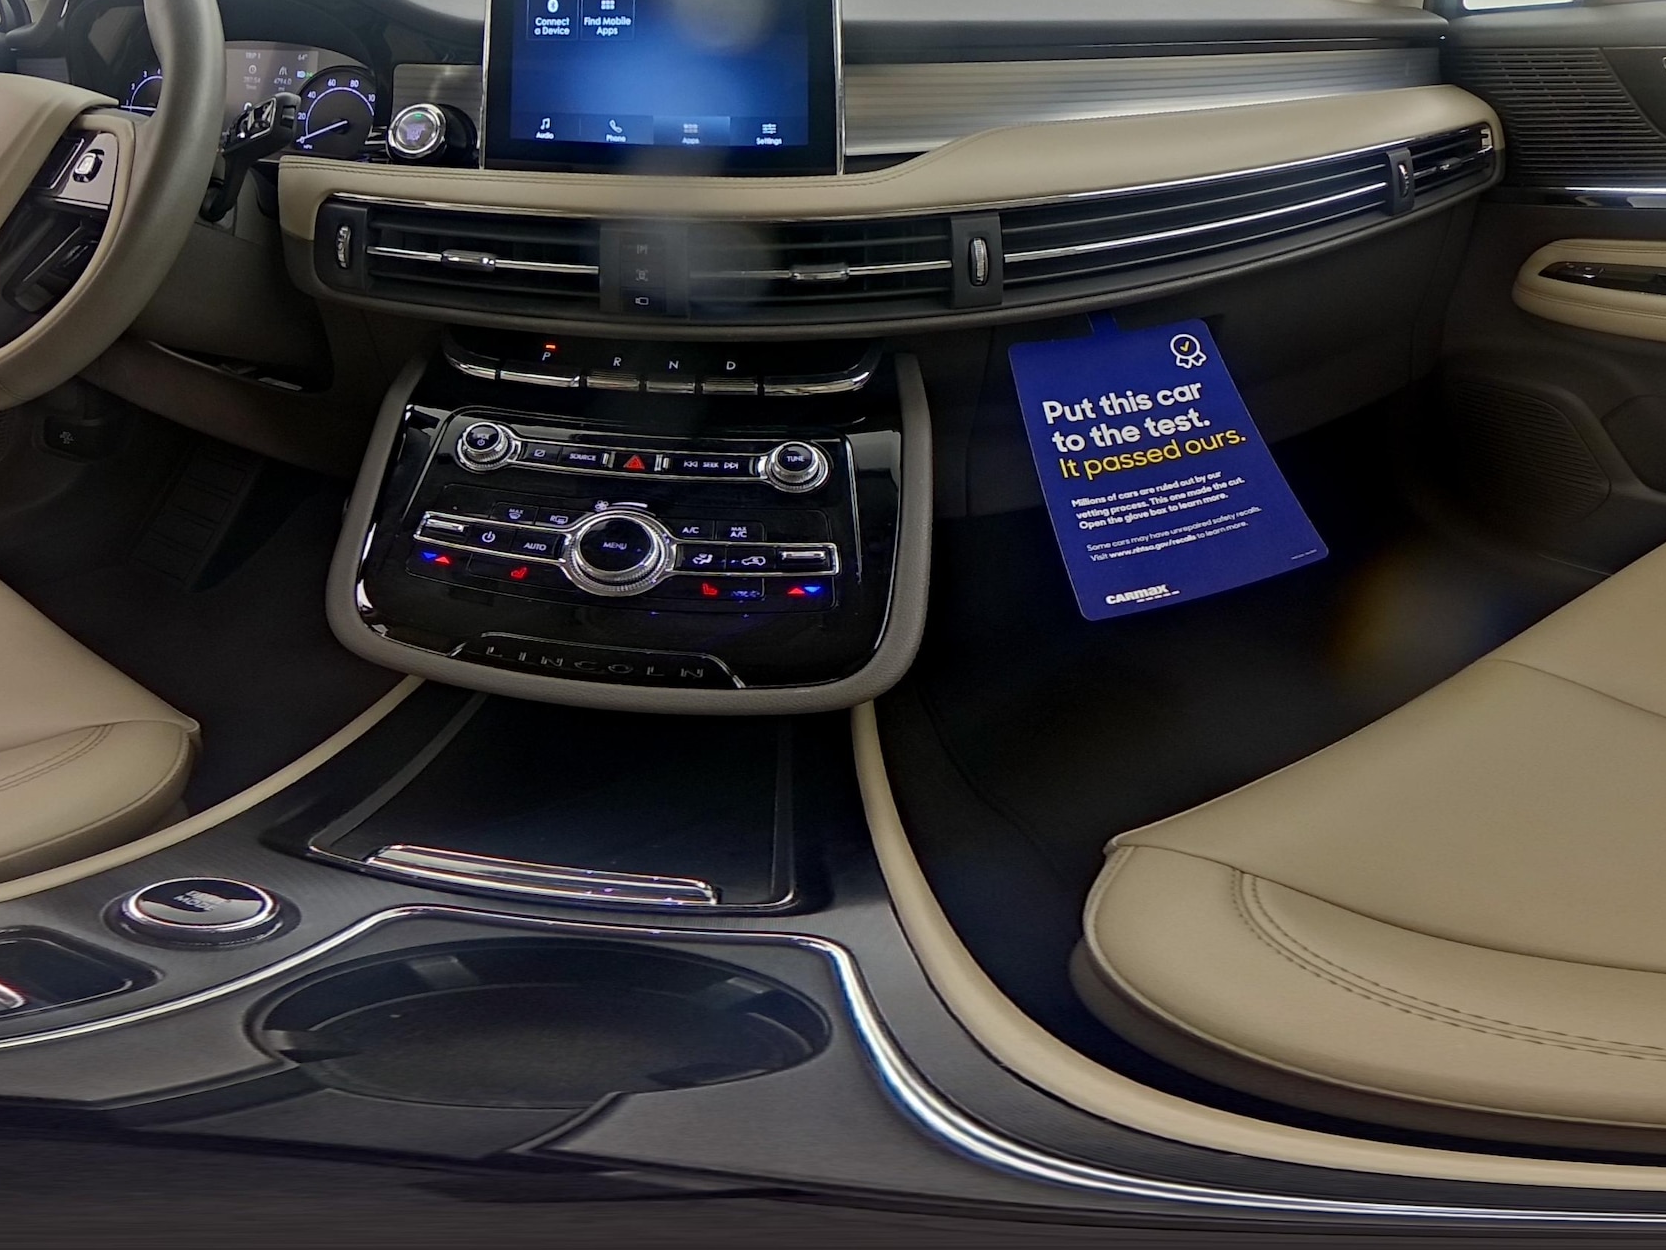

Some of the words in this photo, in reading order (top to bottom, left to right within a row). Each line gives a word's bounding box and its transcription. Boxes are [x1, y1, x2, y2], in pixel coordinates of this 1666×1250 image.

[535, 17, 570, 26] Connect
[584, 17, 601, 26] Find
[603, 16, 631, 26] Mobile
[542, 27, 570, 36] Device
[596, 27, 618, 37] Apps
[327, 79, 337, 87] 60
[350, 79, 359, 88] 80
[307, 91, 317, 99] 40
[297, 112, 307, 120] 20
[542, 352, 551, 361] P
[613, 357, 621, 367] R
[668, 360, 678, 370] N
[726, 361, 736, 370] D
[1043, 398, 1096, 424] Put
[1099, 391, 1152, 415] this
[1157, 383, 1201, 405] car
[1052, 431, 1085, 452] to
[1090, 424, 1140, 447] the
[1144, 408, 1210, 437] test.
[569, 453, 596, 462] SOURCE
[786, 455, 805, 463] TUNE
[1060, 458, 1080, 478] It
[1084, 439, 1181, 480] passed
[1185, 430, 1246, 453] ours.
[1071, 497, 1106, 507] Millions
[1107, 493, 1116, 501] of
[1118, 491, 1139, 499] cars
[1156, 481, 1179, 491] ruled
[1180, 478, 1195, 486] out
[1076, 509, 1110, 520] vetting
[1110, 502, 1149, 515] process.
[1149, 496, 1169, 505] This
[1169, 493, 1186, 501] one
[1187, 486, 1212, 497] made
[1212, 482, 1227, 490] the
[1228, 477, 1245, 486] cut.
[1079, 518, 1106, 529] Open
[1124, 512, 1149, 523] glove
[1149, 508, 1167, 516] box
[1178, 499, 1203, 509] learn
[1203, 493, 1228, 503] more.
[682, 526, 699, 534] A/C
[1087, 543, 1111, 551] Some
[1112, 539, 1130, 547] cars
[1149, 531, 1170, 539] have
[1212, 514, 1235, 524] safety
[524, 542, 546, 551] AUTO
[603, 541, 627, 550] MENU
[1090, 553, 1108, 561] Visit
[1205, 527, 1226, 536] learn
[486, 646, 703, 677] LINCOLN
